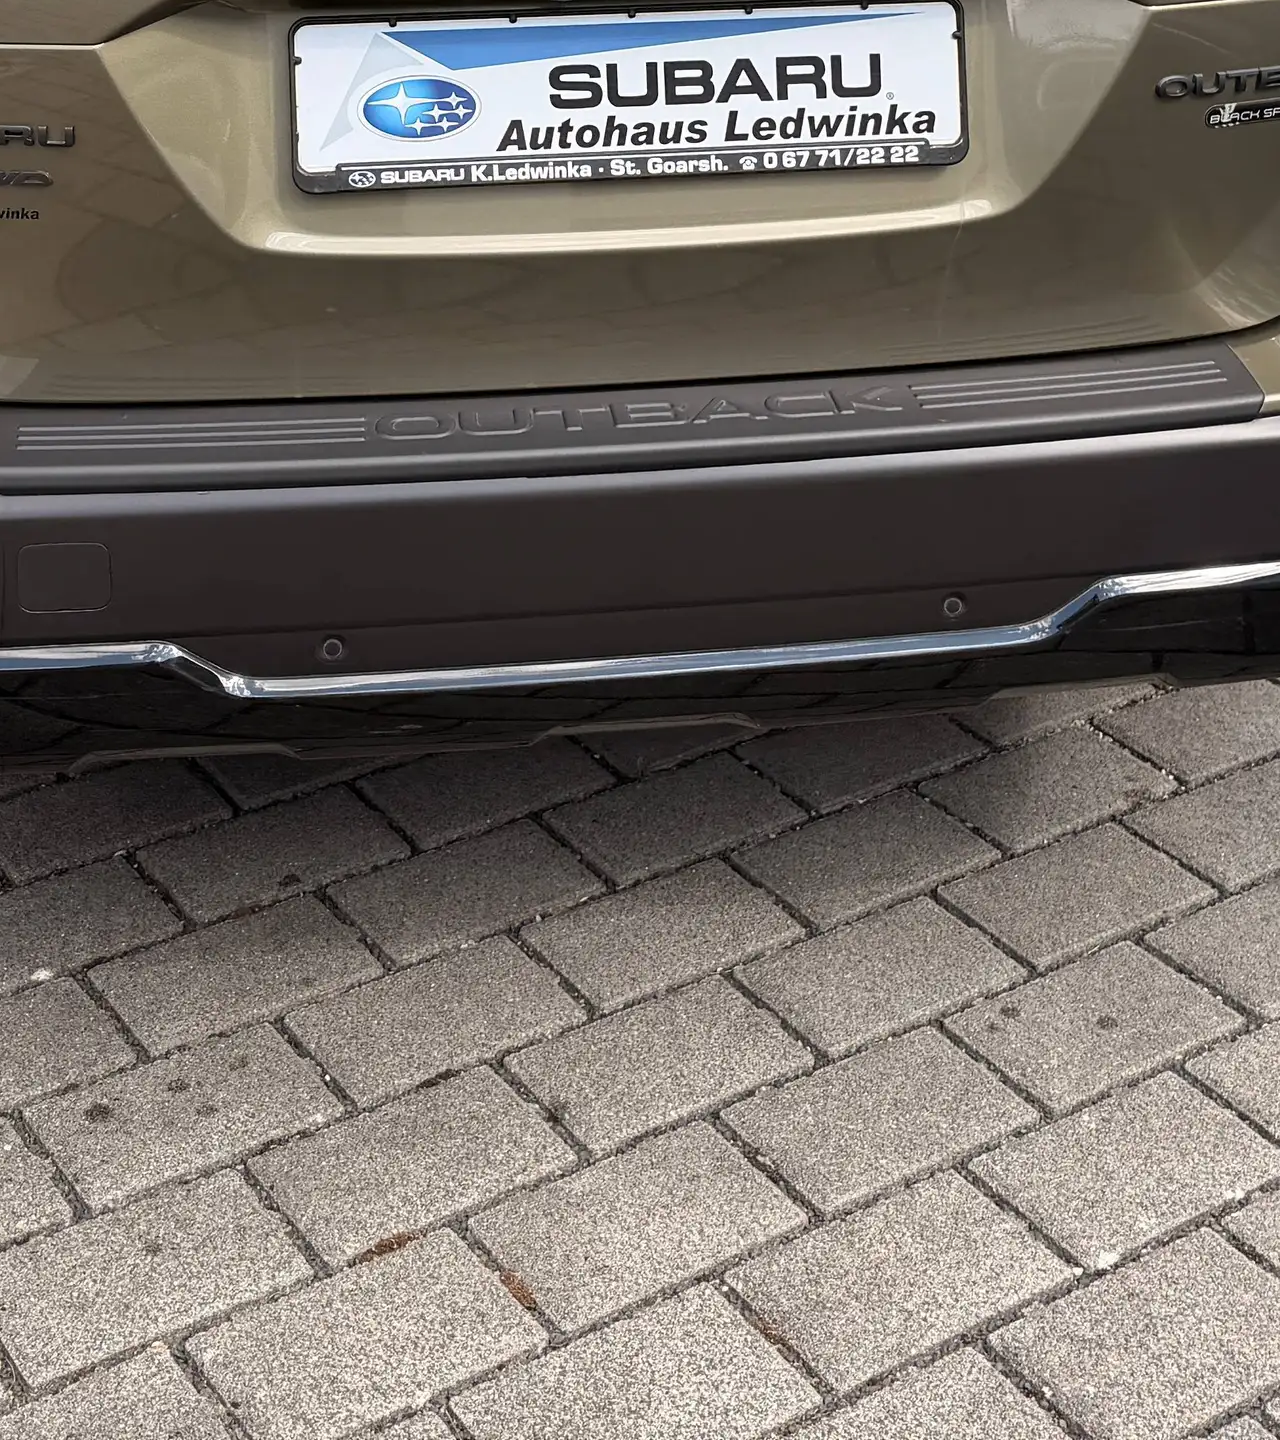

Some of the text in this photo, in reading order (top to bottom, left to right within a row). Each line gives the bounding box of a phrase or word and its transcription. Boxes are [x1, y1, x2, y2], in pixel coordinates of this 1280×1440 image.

[548, 53, 881, 109] SUBARU
[496, 102, 936, 151] Autohaus Ledwinka
[380, 168, 465, 184] SUBARU
[470, 161, 592, 183] K.Ledwinka
[610, 160, 641, 176] St.
[647, 156, 729, 174] Goarsh.
[375, 385, 903, 440] OUTBACK
